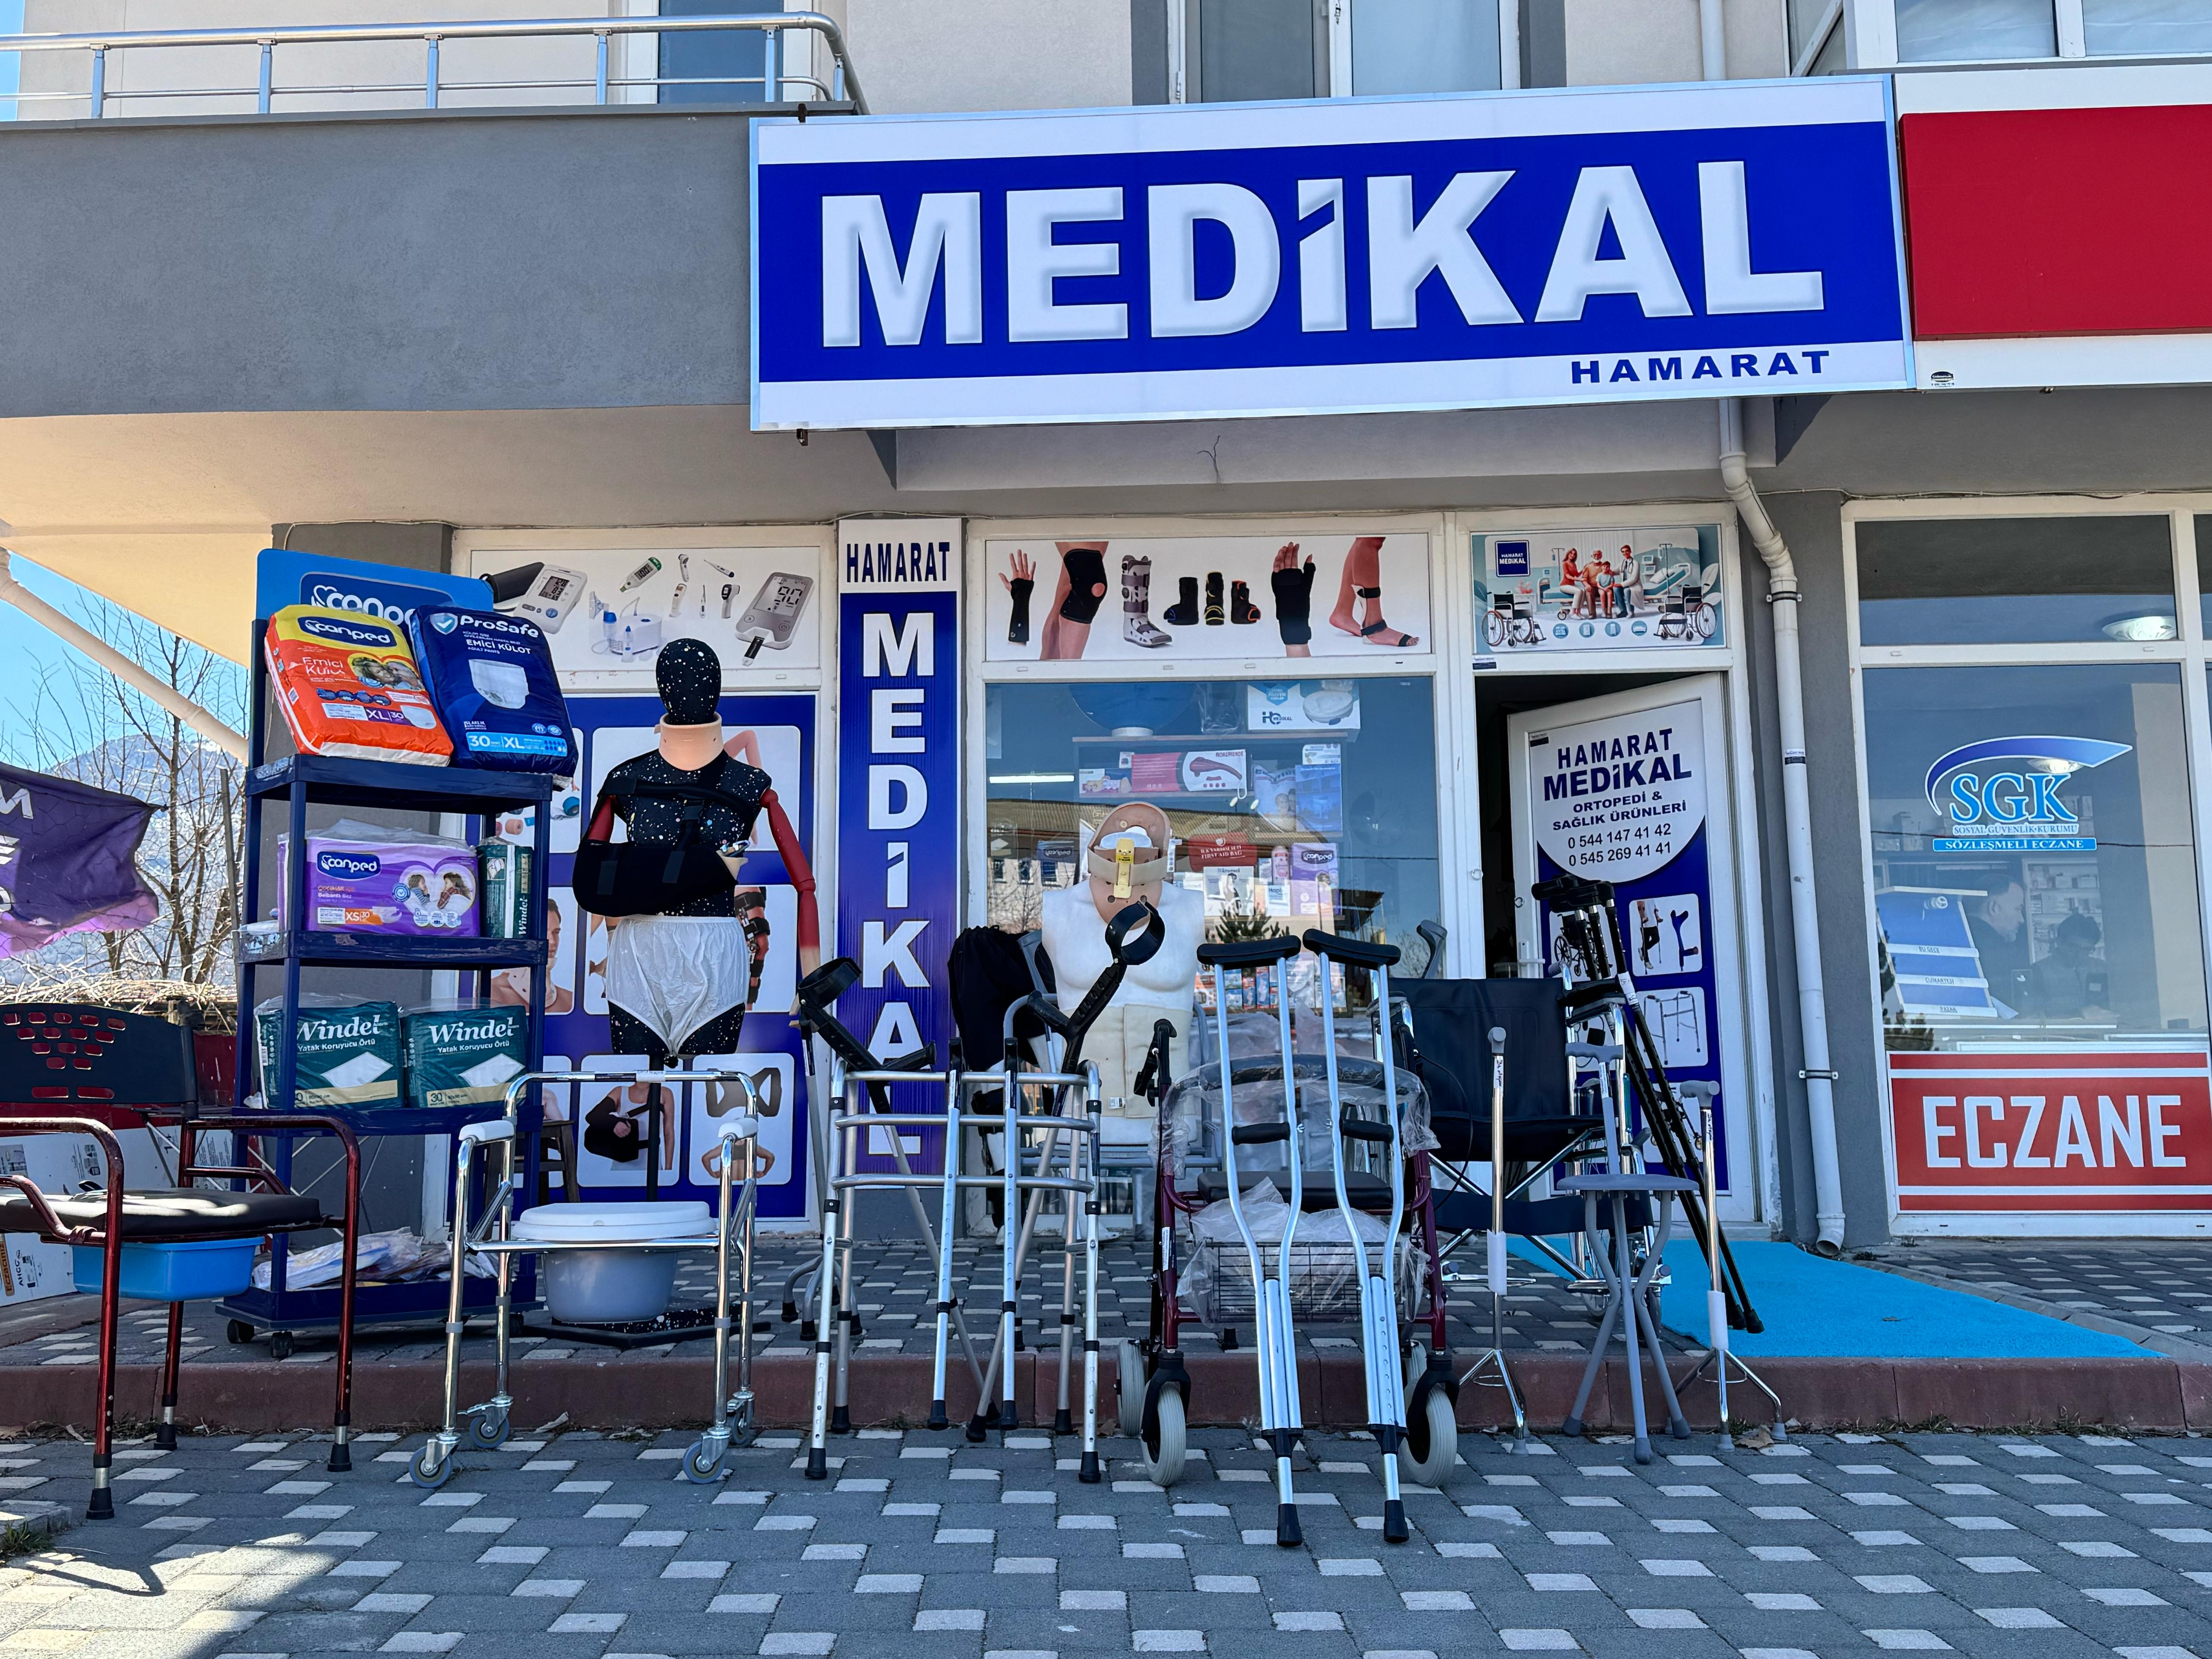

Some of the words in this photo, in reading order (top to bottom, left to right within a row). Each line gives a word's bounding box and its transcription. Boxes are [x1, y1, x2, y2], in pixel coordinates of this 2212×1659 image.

[821, 159, 1826, 349] MEDİKAL
[1572, 350, 1831, 385] HAMARAT
[846, 541, 950, 583] HAMARAT
[315, 623, 391, 644] canped
[460, 615, 539, 638] ProSafe
[466, 639, 496, 648] EMİCİ
[498, 643, 531, 655] KÜLOT
[366, 709, 389, 721] XL
[468, 735, 491, 747] 30
[503, 736, 525, 749] XL
[1557, 728, 1672, 769] HAMARAT
[1544, 753, 1692, 801] MEDİKAL
[1573, 791, 1646, 813] ORTOPEDİ
[1652, 791, 1662, 801] &
[1949, 772, 2079, 823] SGK
[1553, 814, 1606, 831] SAĞLIK
[1610, 800, 1686, 822] ÜRÜNLERİ
[1568, 837, 1575, 849] 0
[1579, 833, 1603, 848] 544
[1606, 829, 1630, 844] 147
[1634, 826, 1649, 840] 41
[1654, 823, 1672, 836] 42
[1954, 826, 1986, 834] SOSYAL
[1569, 855, 1576, 867] 0
[1580, 850, 1603, 865] 545
[1608, 846, 1631, 861] 269
[1635, 844, 1650, 858] 41
[1655, 841, 1671, 855] 41
[1945, 839, 2028, 850] SÖZLEŞMELİ
[2032, 840, 2084, 849] ECZANE
[327, 858, 378, 873] canped
[346, 912, 360, 922] XS
[518, 897, 528, 935] Windel
[297, 1014, 381, 1041] Windel
[429, 1017, 514, 1044] Windel
[298, 1044, 320, 1053] Yatak
[322, 1040, 357, 1051] Koruyucu
[359, 1038, 376, 1046] Örtü
[438, 1045, 458, 1054] Yatak
[459, 1043, 493, 1052] Koruyucu
[430, 1093, 443, 1103] 30
[1922, 1095, 2187, 1168] ECZANE
